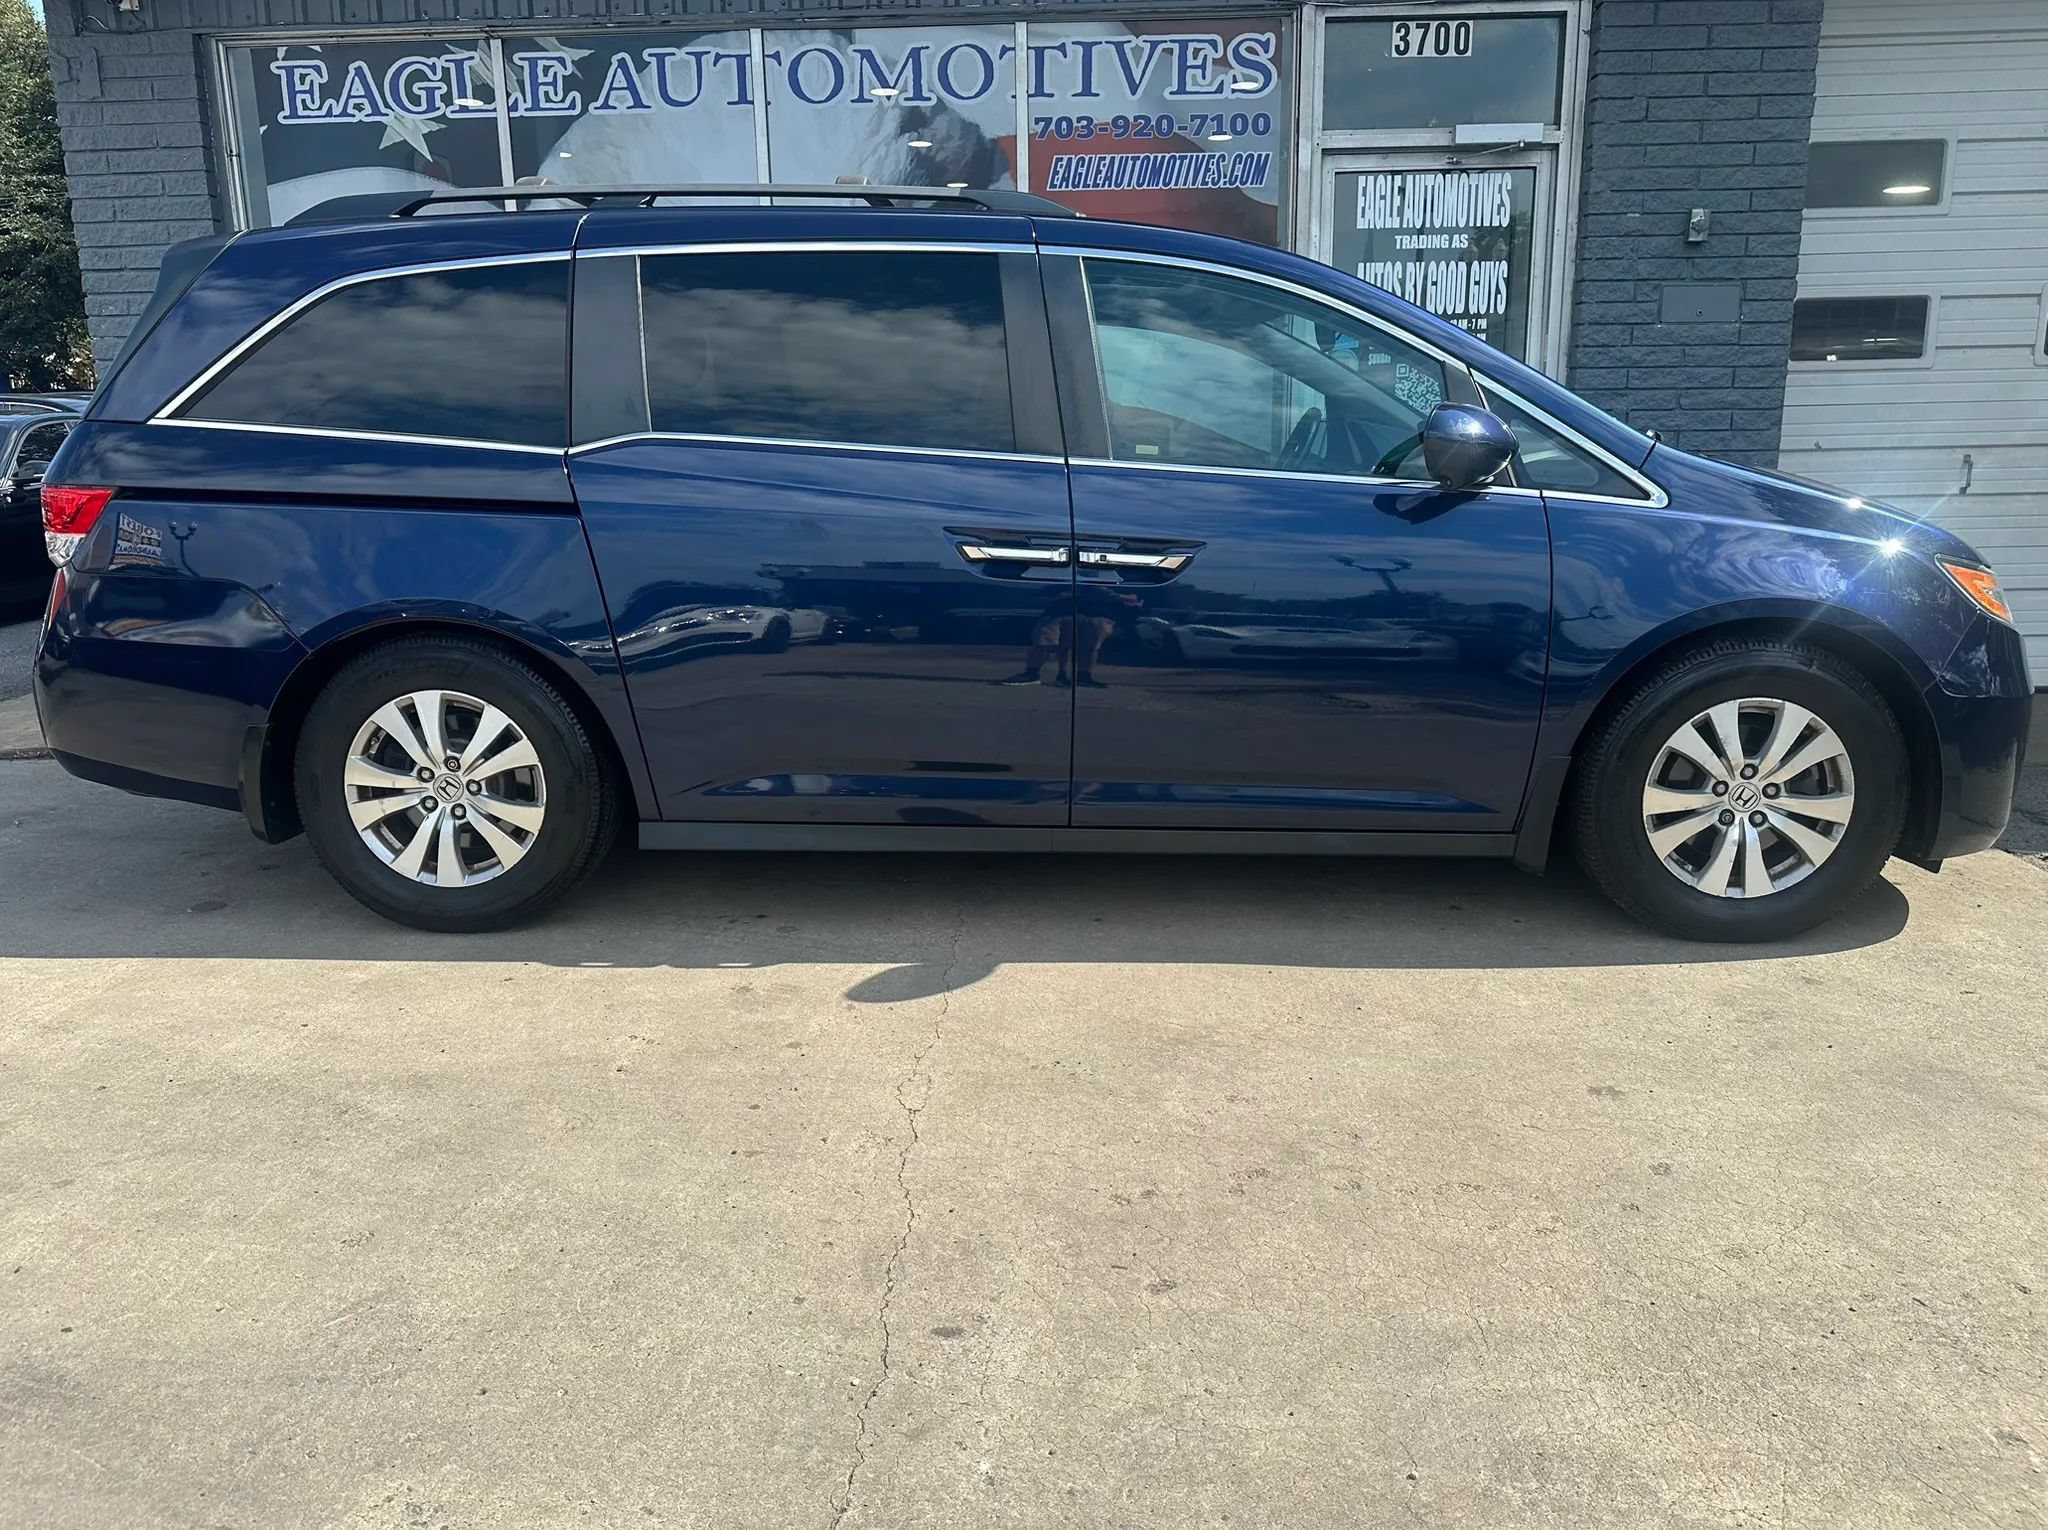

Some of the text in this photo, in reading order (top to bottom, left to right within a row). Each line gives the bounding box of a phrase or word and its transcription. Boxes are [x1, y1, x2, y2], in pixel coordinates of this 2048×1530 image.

[1394, 21, 1471, 56] 3700
[272, 33, 1276, 123] EAGLE AUTOMOTIVES
[1034, 112, 1272, 140] 703-920-7100
[1047, 152, 1271, 191] EAGLEAUTOMOTIVES.COM
[1356, 172, 1512, 229] EAGLE AUTOMOTIVES
[1395, 234, 1469, 249] TRADING AS
[1405, 261, 1425, 306] BY
[1426, 260, 1467, 315] GOOD
[1469, 260, 1508, 315] GUYS
[1477, 318, 1487, 330] PM
